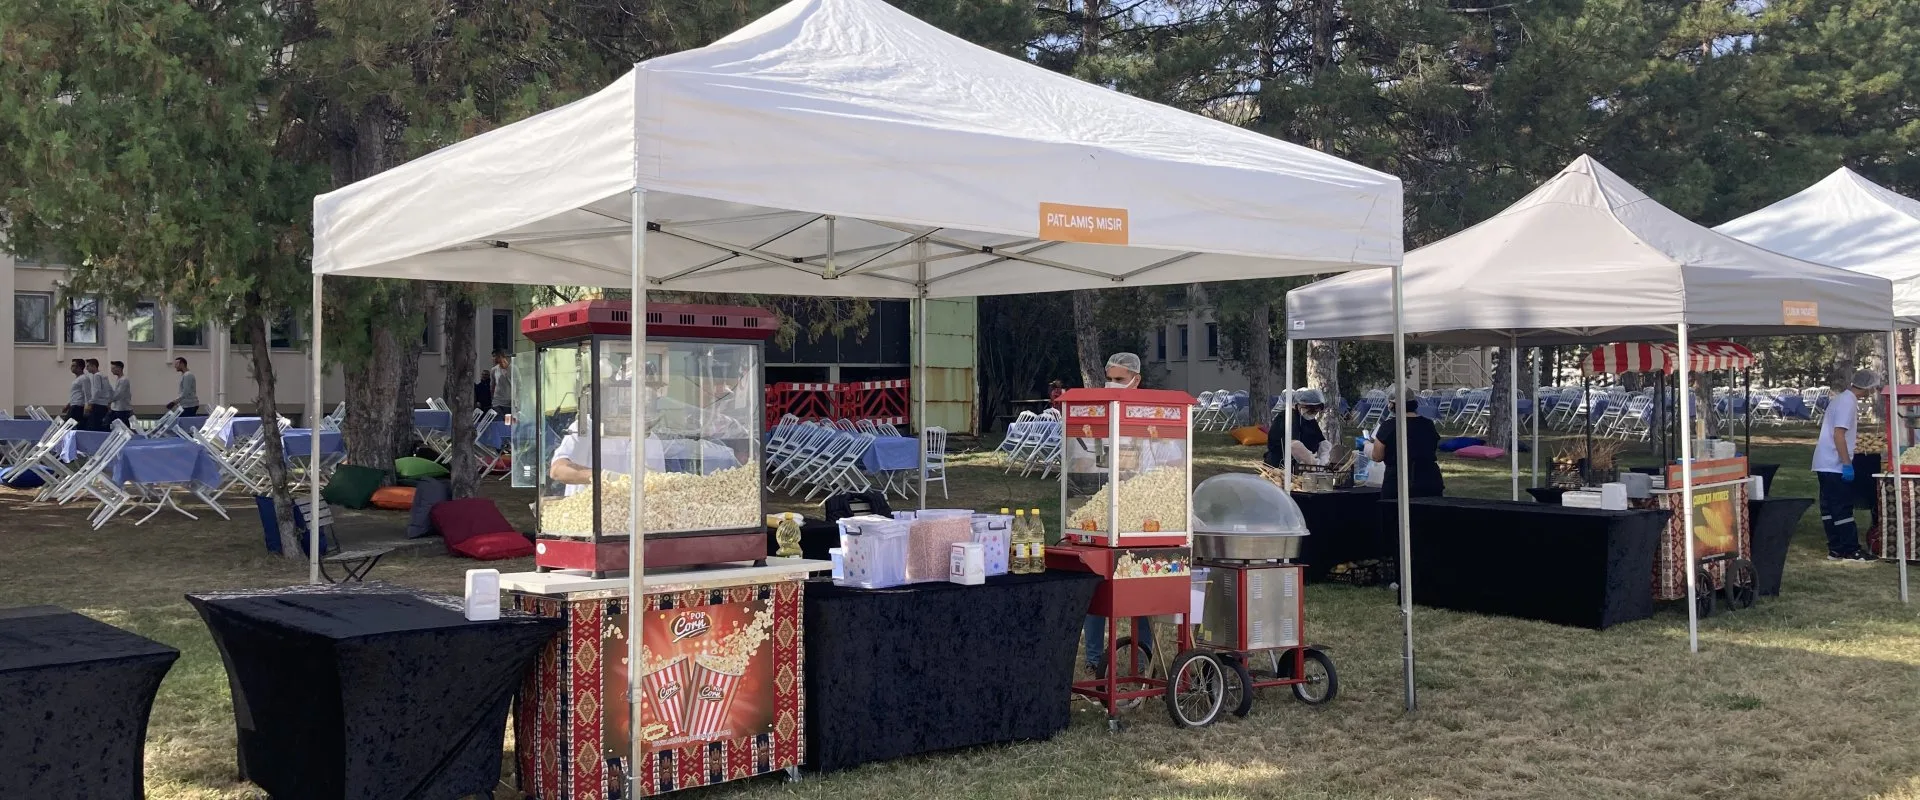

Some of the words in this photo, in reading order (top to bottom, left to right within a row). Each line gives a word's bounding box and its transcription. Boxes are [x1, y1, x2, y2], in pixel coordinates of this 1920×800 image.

[1047, 213, 1094, 232] PATLAMIŞ
[1096, 217, 1122, 231] MISIR
[690, 611, 706, 619] POP
[674, 617, 707, 636] Corn
